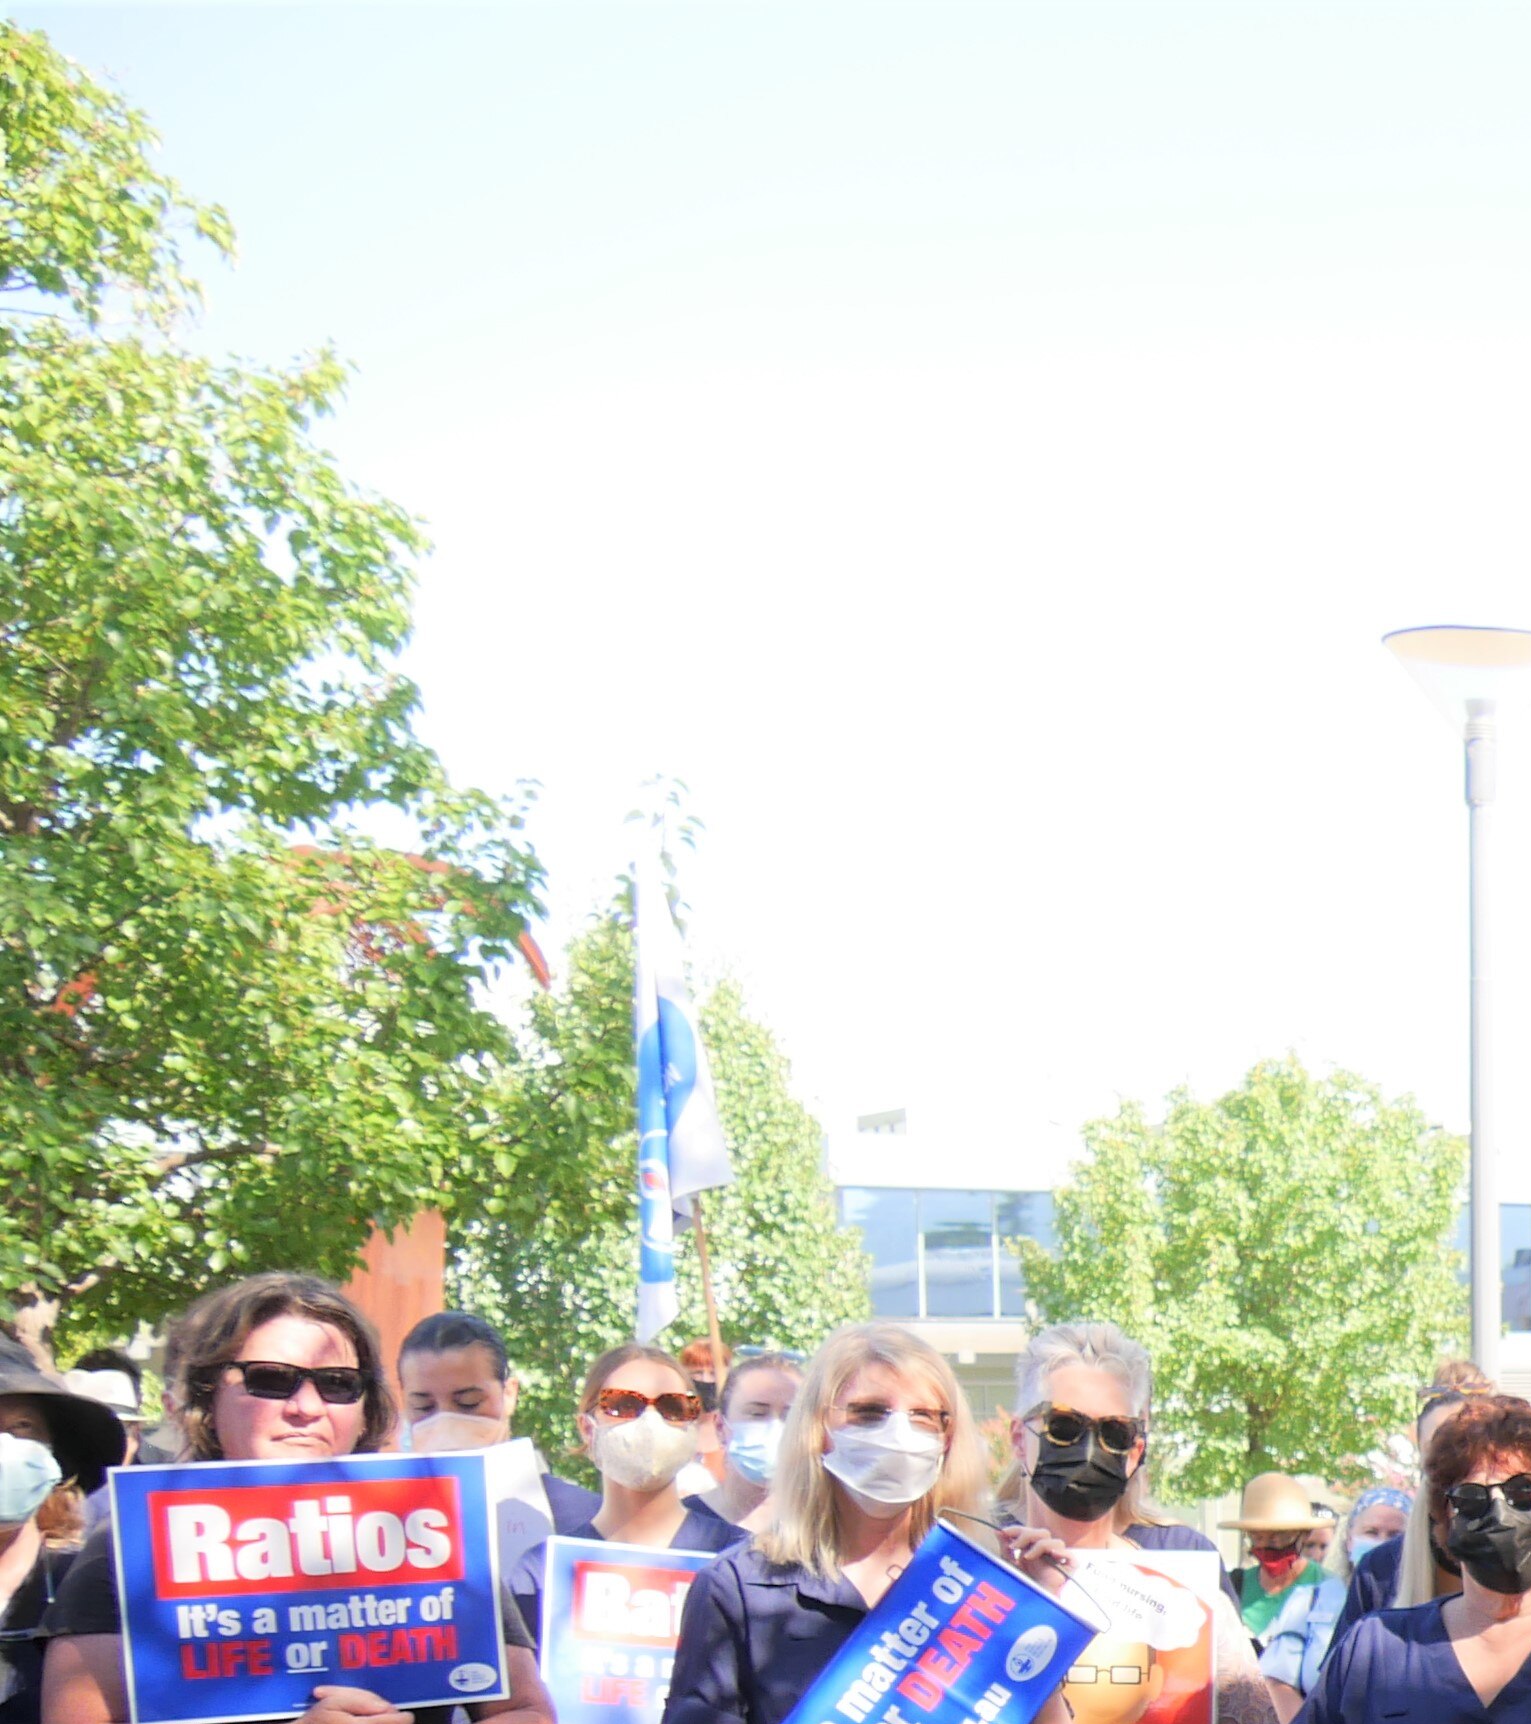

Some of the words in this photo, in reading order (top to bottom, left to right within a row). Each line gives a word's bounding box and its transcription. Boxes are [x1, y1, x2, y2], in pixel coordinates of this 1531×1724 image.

[167, 1495, 452, 1584] Ratios
[176, 1604, 242, 1639] It's
[253, 1606, 278, 1633] a
[289, 1594, 412, 1632] matter
[419, 1587, 455, 1621] of
[836, 1604, 941, 1724] matter
[932, 1555, 976, 1605] of
[897, 1582, 1016, 1713] DEATH
[180, 1640, 273, 1680] LIFE
[285, 1638, 328, 1672] or
[338, 1626, 459, 1669] DEATH
[580, 1675, 648, 1707] LIFE
